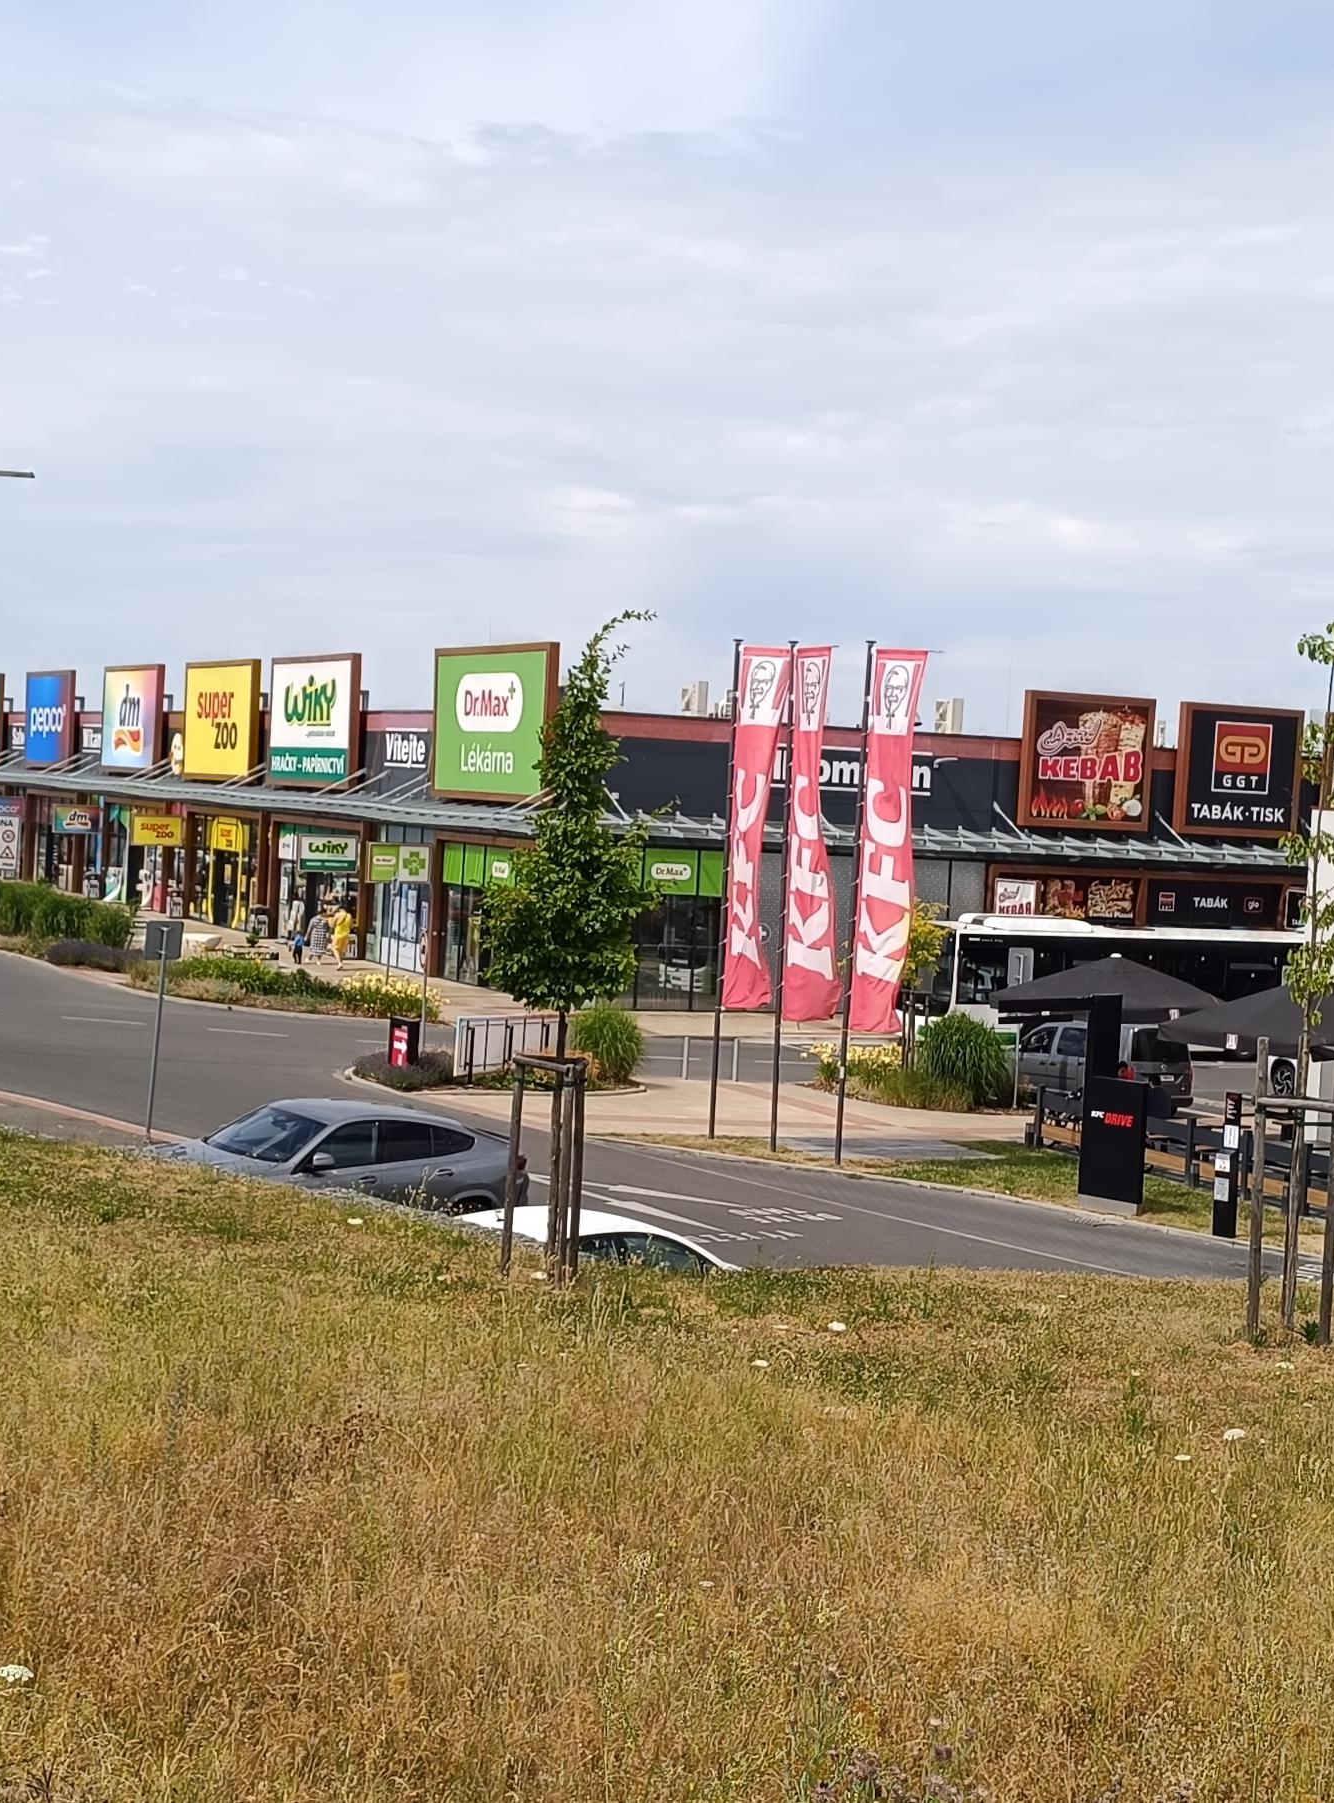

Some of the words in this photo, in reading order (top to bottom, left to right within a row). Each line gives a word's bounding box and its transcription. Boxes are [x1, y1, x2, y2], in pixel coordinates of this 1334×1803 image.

[197, 691, 234, 727] super
[271, 753, 298, 772] HRAČKY
[302, 753, 345, 774] PAPÍRNICTVÍ
[385, 732, 426, 768] Vítejte
[460, 744, 514, 774] Lékárna
[1038, 750, 1144, 784] KEBAB
[1222, 774, 1260, 789] GGT
[69, 810, 88, 822] dm
[140, 822, 171, 833] super
[731, 768, 766, 971] KFC
[787, 774, 834, 981] KFC
[856, 777, 912, 984] KFC
[1193, 896, 1228, 909] TABÁK
[1091, 1110, 1104, 1119] KFC
[1104, 1113, 1134, 1128] DRIVE
